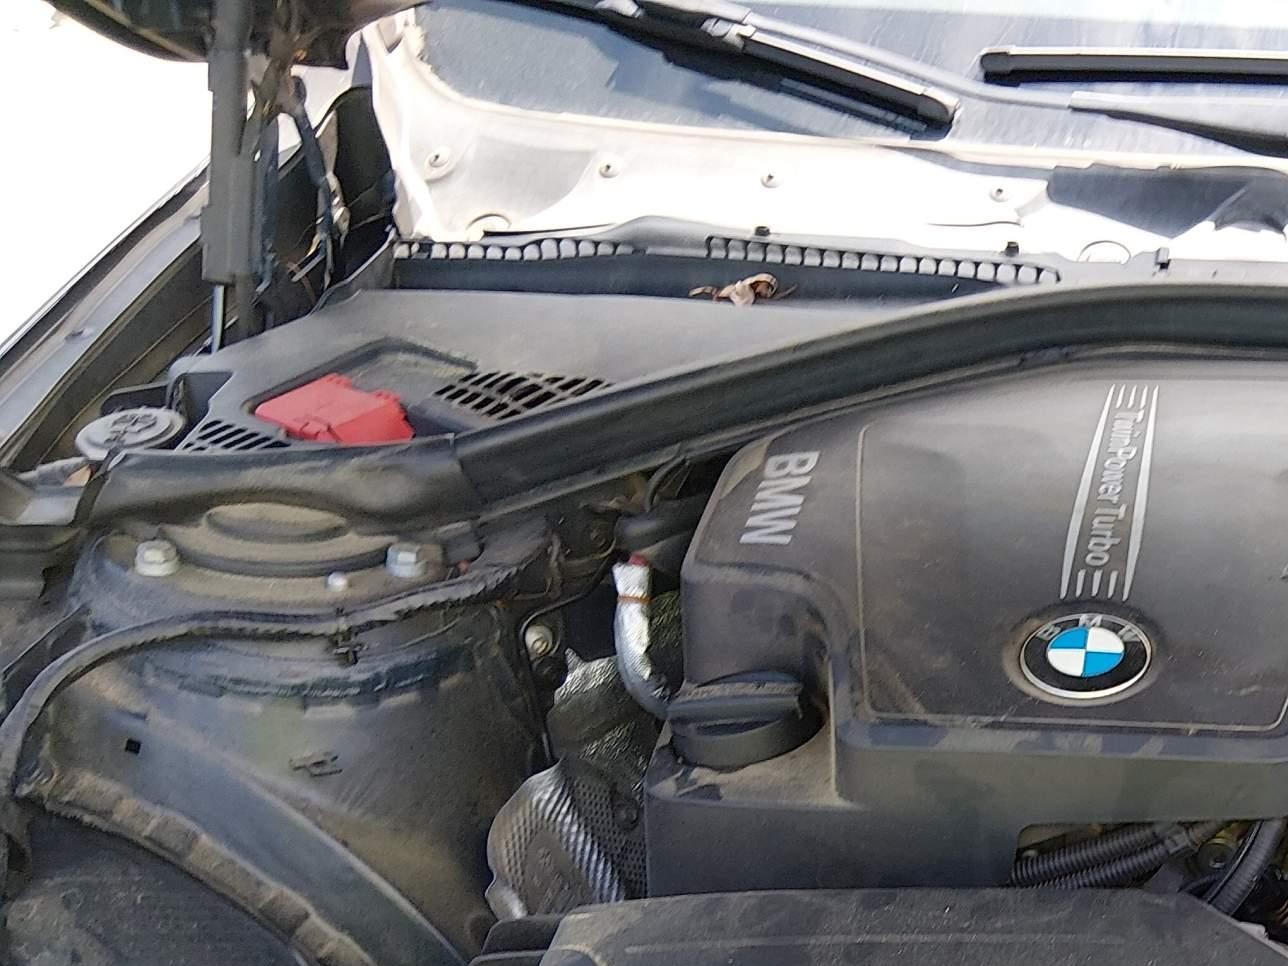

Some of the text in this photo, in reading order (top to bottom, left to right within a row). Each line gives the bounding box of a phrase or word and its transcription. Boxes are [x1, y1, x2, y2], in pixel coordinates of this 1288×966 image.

[739, 451, 821, 545] BMW
[1085, 409, 1145, 567] TwinPower Turbo
[1034, 612, 1141, 642] BMW
